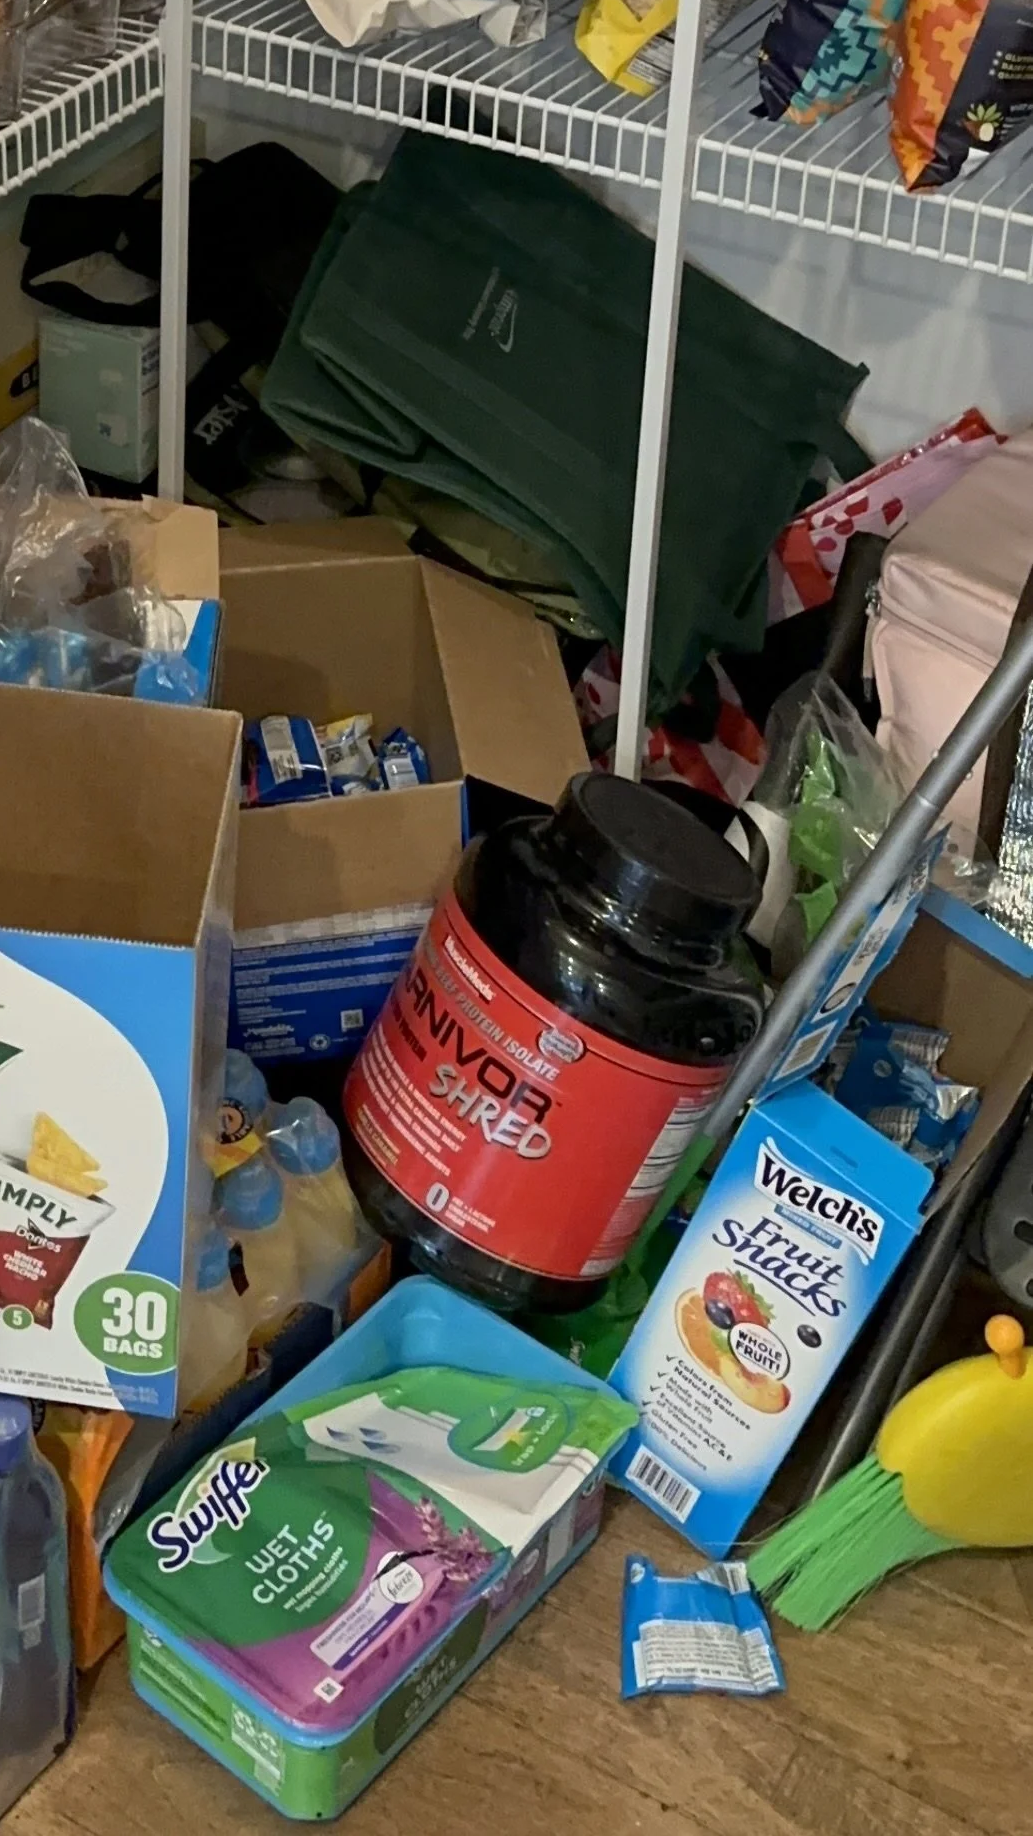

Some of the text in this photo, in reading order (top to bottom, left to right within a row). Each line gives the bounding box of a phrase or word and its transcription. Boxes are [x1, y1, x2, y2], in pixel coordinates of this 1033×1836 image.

[458, 994, 560, 1082] PROTEIN ISOLATE
[428, 1064, 552, 1159] SHRED
[426, 1181, 449, 1213] 0
[758, 1154, 877, 1245] Welch's
[13, 1250, 44, 1268] WHITE
[15, 1222, 62, 1254] Doritos
[746, 1215, 847, 1286] Fruit
[3, 1254, 47, 1278] CHEDDAR
[4, 1263, 39, 1282] NACHO
[711, 1218, 848, 1318] Snacks
[13, 1310, 24, 1326] 5
[102, 1287, 167, 1340] 30
[103, 1337, 163, 1360] BAGS
[734, 1341, 781, 1375] FRUIT!
[737, 1329, 783, 1361] WHOLE
[665, 1382, 714, 1424] Whole Fruit
[668, 1376, 714, 1416] Made with
[674, 1365, 752, 1431] Natural Sources
[677, 1358, 733, 1407] Colors from
[649, 1408, 699, 1451] Gluten Free
[655, 1399, 703, 1441] of Vitamins
[659, 1392, 727, 1450] Excellent Source
[152, 1459, 269, 1570] Swiffer
[244, 1523, 294, 1574] WET
[251, 1518, 335, 1604] CLOTHS
[296, 1568, 326, 1600] mopping
[322, 1546, 345, 1574] cloths
